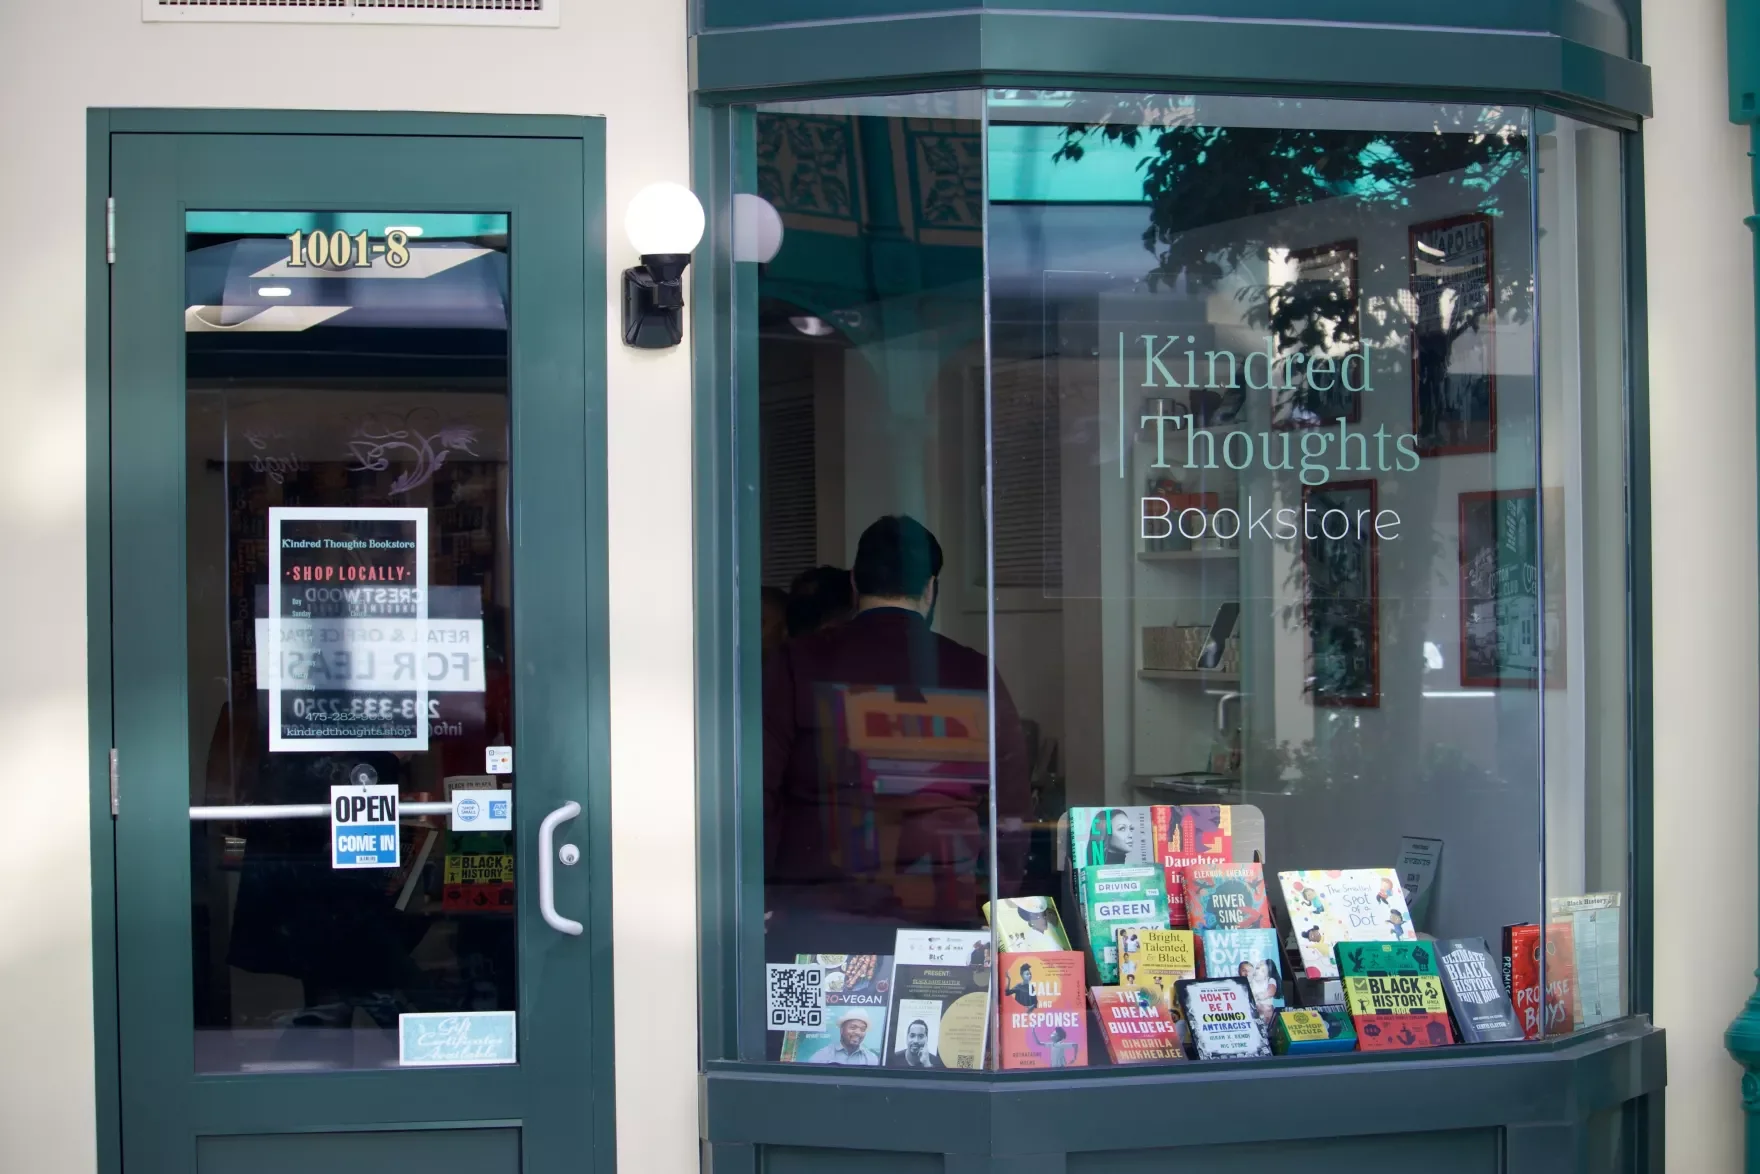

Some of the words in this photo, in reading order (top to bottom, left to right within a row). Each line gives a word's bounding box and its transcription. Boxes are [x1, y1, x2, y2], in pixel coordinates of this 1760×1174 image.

[287, 229, 411, 268] 1001-8
[1141, 335, 1374, 392] Kindred
[1141, 414, 1420, 486] Thoughts
[1141, 496, 1401, 540] Bookstore
[282, 539, 320, 548] Kindred
[324, 539, 367, 550] Thoughts
[369, 539, 415, 549] Bookstore
[293, 566, 333, 580] SHOP
[339, 566, 405, 580] LOCALLY
[287, 727, 412, 737] kindredthoughts.shop
[335, 795, 396, 823] OPEN
[338, 834, 377, 852] COME
[380, 834, 395, 851] IN
[462, 856, 502, 868] BLACK
[1165, 855, 1226, 868] Daughter
[462, 868, 502, 879] HISTORY
[1099, 883, 1138, 891] DRIVING
[1325, 884, 1340, 895] The
[1212, 894, 1246, 908] RIVER
[1343, 893, 1371, 907] Spot
[1100, 904, 1150, 916] GREEN
[1351, 905, 1361, 913] of
[1218, 910, 1244, 923] SING
[1349, 912, 1379, 927] Dot
[1149, 932, 1183, 943] Bright,
[1209, 932, 1240, 948] WE
[1143, 943, 1189, 953] Talented,
[1158, 953, 1187, 962] Black
[1211, 948, 1261, 964] OVER
[1442, 949, 1486, 964] ULTIMATE
[1445, 961, 1491, 980] BLACK
[1029, 981, 1061, 997] CALL
[1368, 977, 1422, 994] BLACK
[1452, 977, 1496, 993] HISTORY
[1116, 990, 1144, 1003] THE
[1200, 993, 1222, 1002] HOW
[1223, 992, 1236, 1000] TO
[1372, 995, 1424, 1007] HISTORY
[1457, 991, 1484, 1004] TRIVIA
[1480, 989, 1500, 1003] BOOK
[1111, 1006, 1159, 1019] DREAM
[1209, 1003, 1223, 1012] BE
[1227, 1003, 1233, 1011] A
[1012, 1012, 1079, 1028] RESPONSE
[1203, 1012, 1246, 1022] (YOUNG)
[438, 1016, 472, 1036] Gift
[1108, 1021, 1174, 1034] BUILDERS
[1202, 1021, 1252, 1031] ANTIRACIST
[418, 1032, 502, 1048] Certificates
[1121, 1038, 1172, 1049] OINDRILA
[1120, 1049, 1183, 1060] MUKHERJEE
